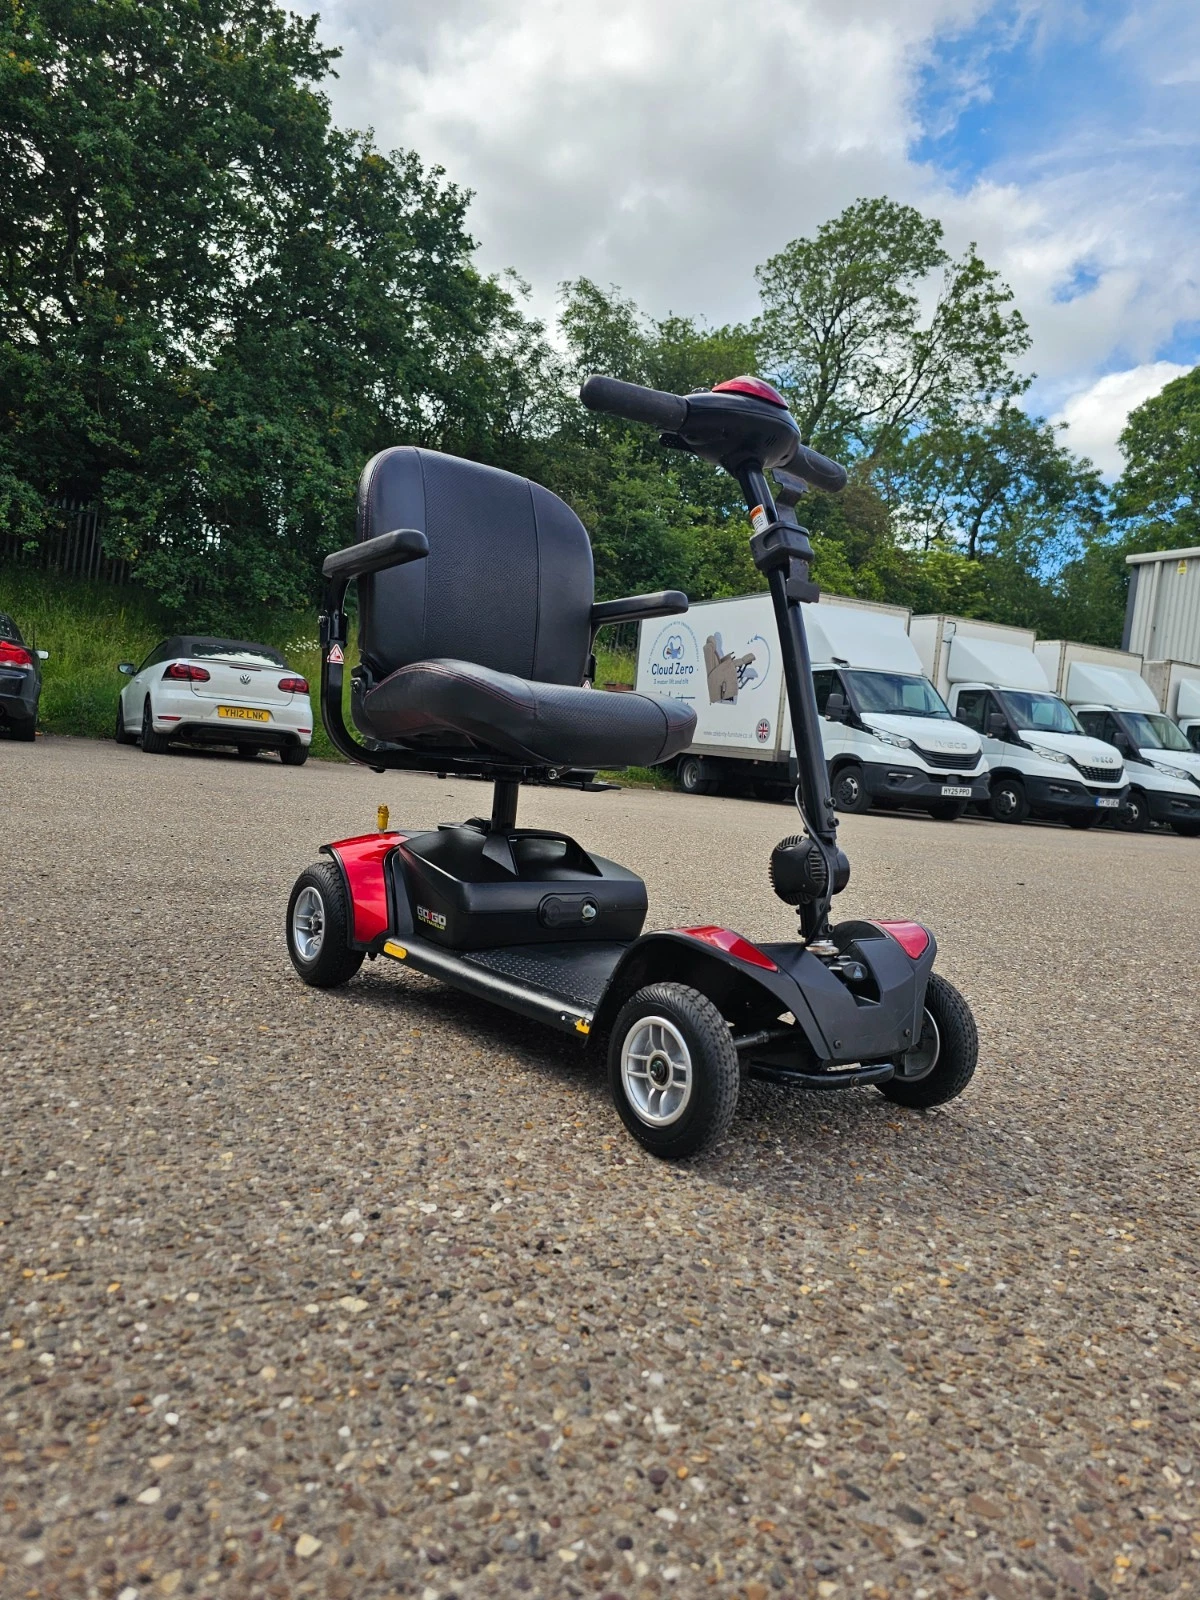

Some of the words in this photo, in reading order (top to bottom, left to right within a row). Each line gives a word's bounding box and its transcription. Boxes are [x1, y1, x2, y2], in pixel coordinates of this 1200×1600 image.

[651, 662, 674, 675] Cloud
[675, 662, 694, 675] Zero
[225, 708, 245, 718] YH12
[246, 710, 264, 720] LNK
[934, 740, 968, 750] IVECO
[943, 787, 959, 795] HY25
